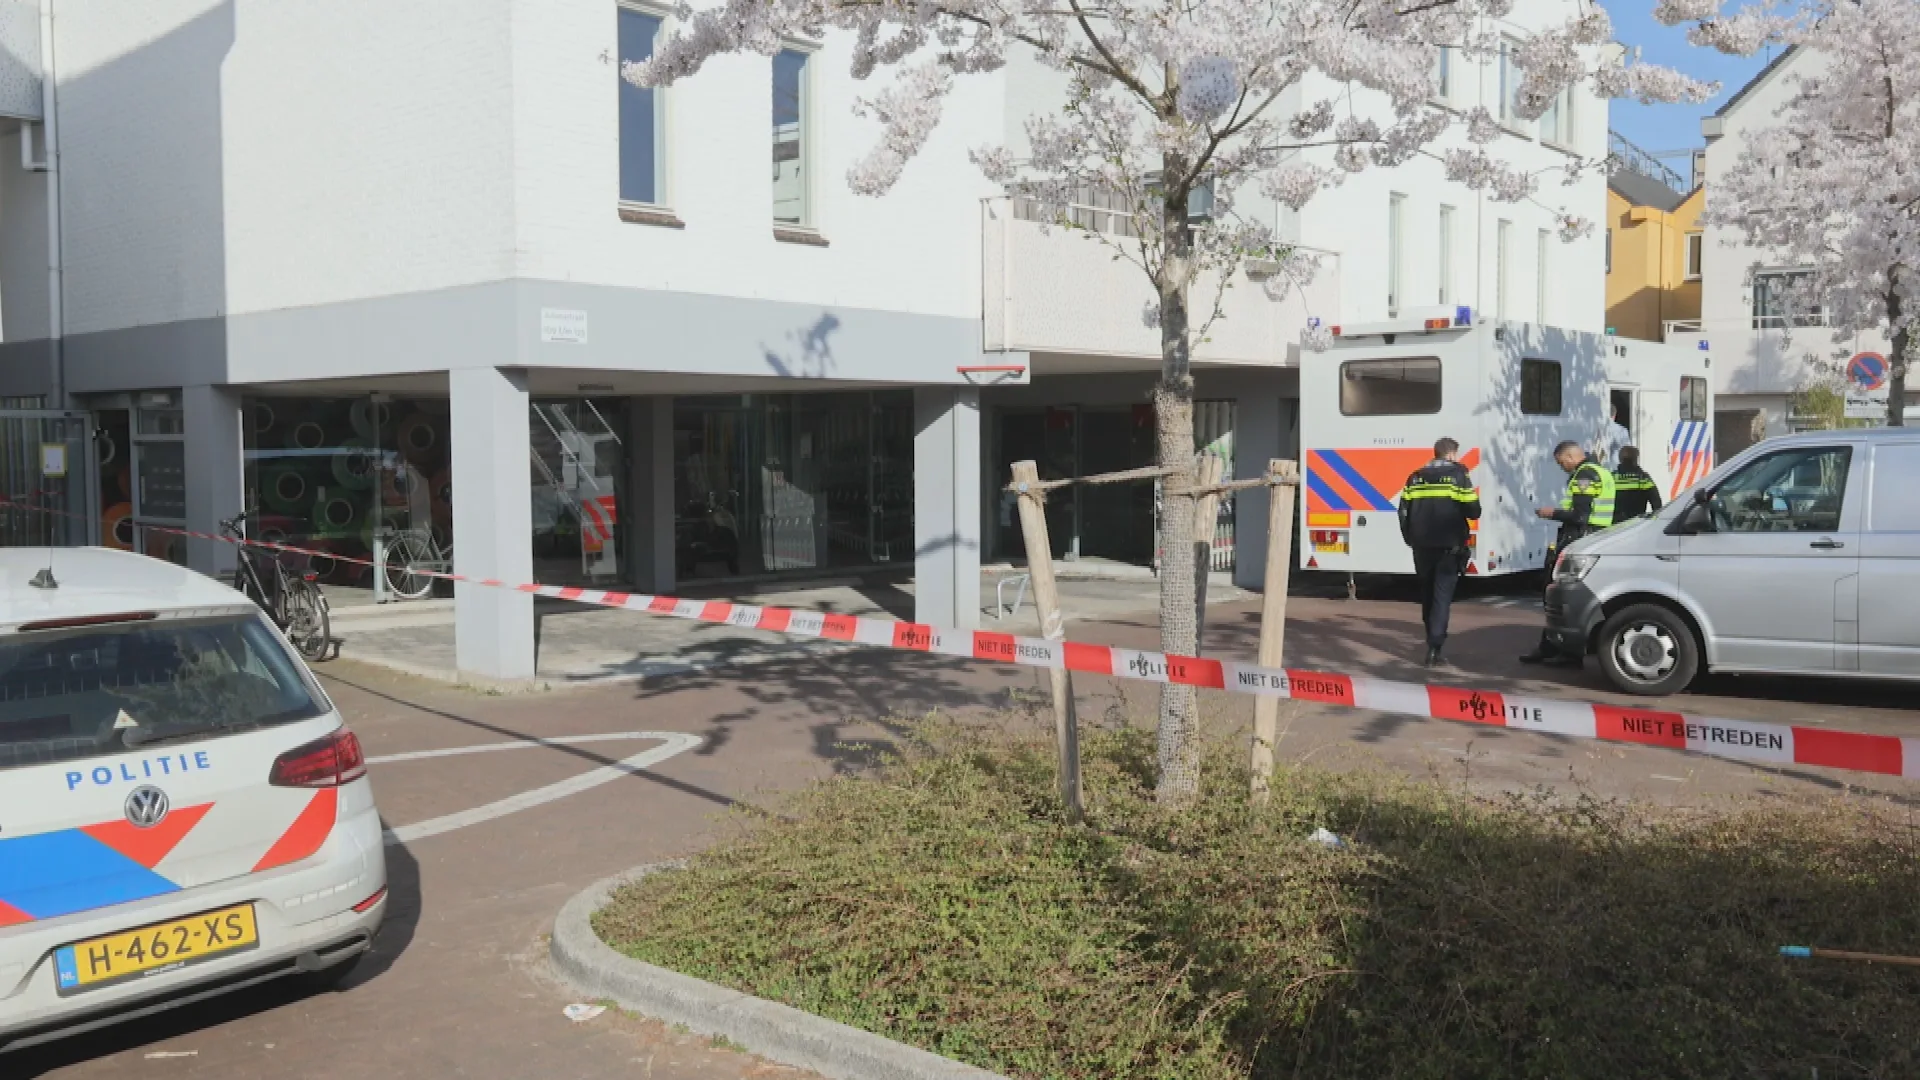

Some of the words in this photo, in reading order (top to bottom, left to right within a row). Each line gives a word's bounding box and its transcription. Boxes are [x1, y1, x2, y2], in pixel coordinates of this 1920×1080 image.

[1373, 437, 1405, 445] POLITIE
[901, 630, 941, 647] POLITIE
[977, 639, 998, 653] NIET
[1000, 644, 1052, 660] BETREDEN
[1129, 655, 1186, 678] POLITIE
[1238, 671, 1267, 687] NIET
[1270, 673, 1345, 697] BETREDEN
[1459, 696, 1543, 723] POLITIE
[1622, 716, 1665, 735] NIET
[1672, 722, 1783, 751] BETREDEN
[65, 751, 211, 791] POLITIE
[88, 913, 243, 976] H-462-XS
